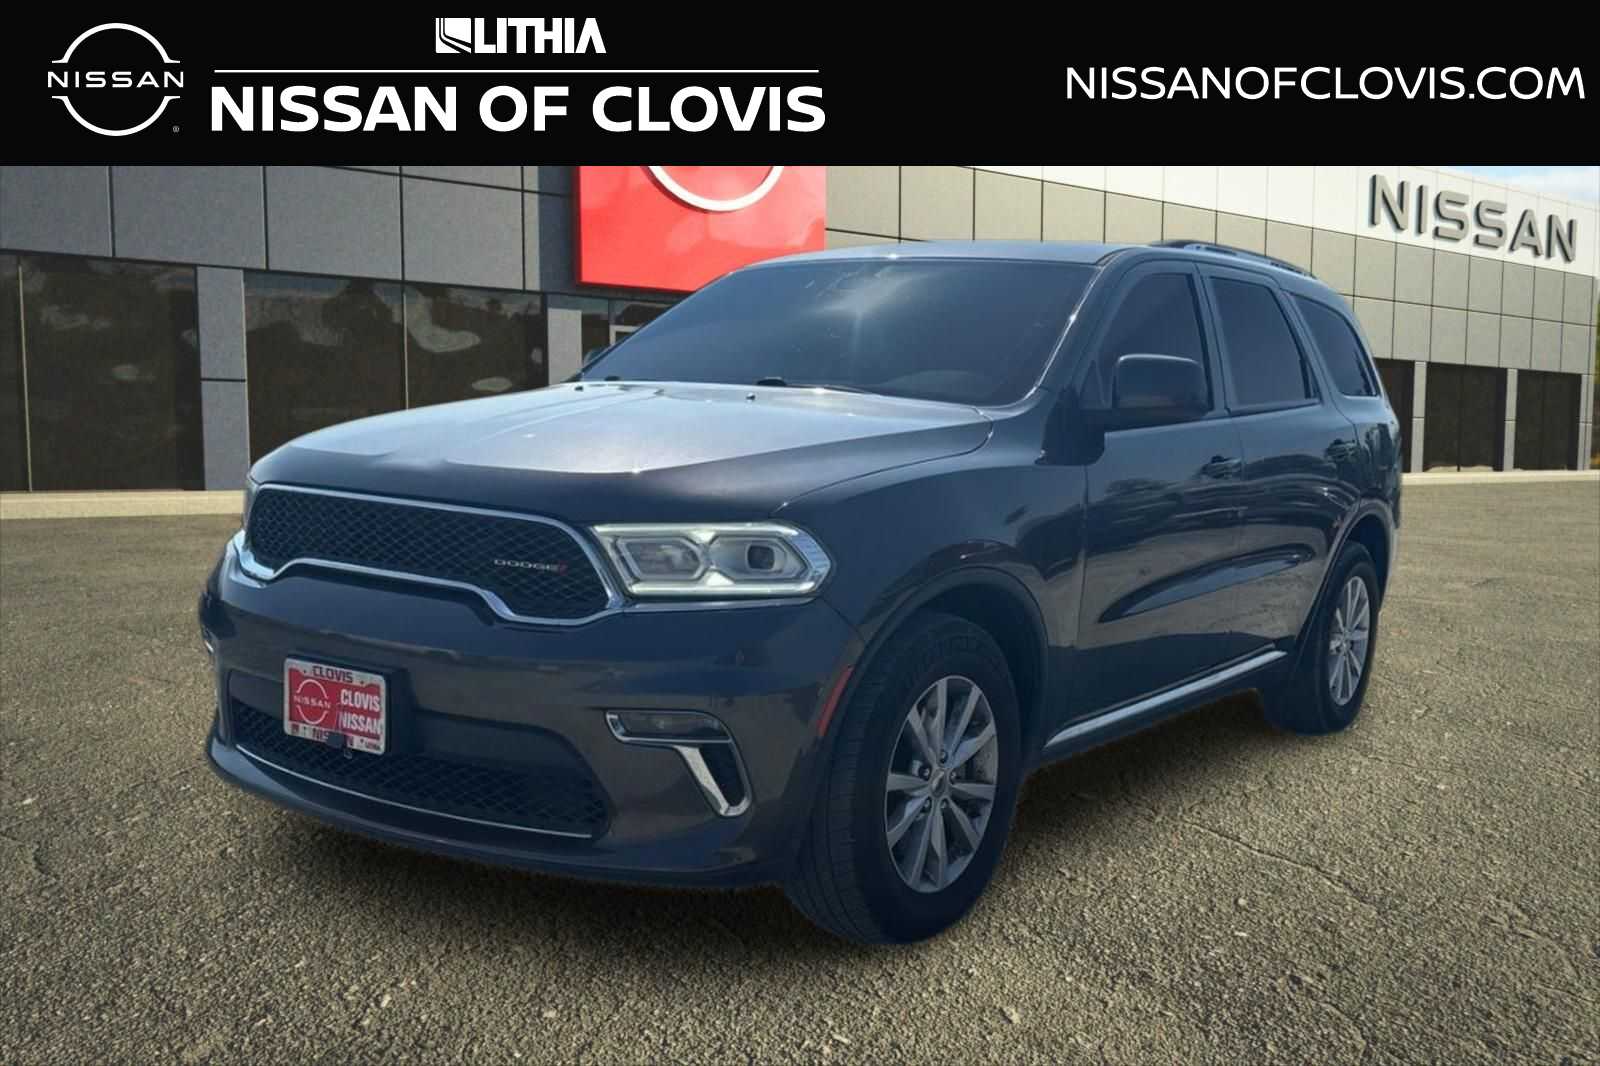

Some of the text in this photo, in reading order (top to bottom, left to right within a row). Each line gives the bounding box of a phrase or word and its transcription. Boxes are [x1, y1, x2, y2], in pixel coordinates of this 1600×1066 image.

[1368, 173, 1578, 263] NISSAN
[494, 559, 558, 572] DODGE
[312, 665, 353, 683] CLOVIS
[293, 695, 331, 709] NISSAN
[340, 688, 380, 712] CLOVIS
[339, 711, 383, 735] NISSAN
